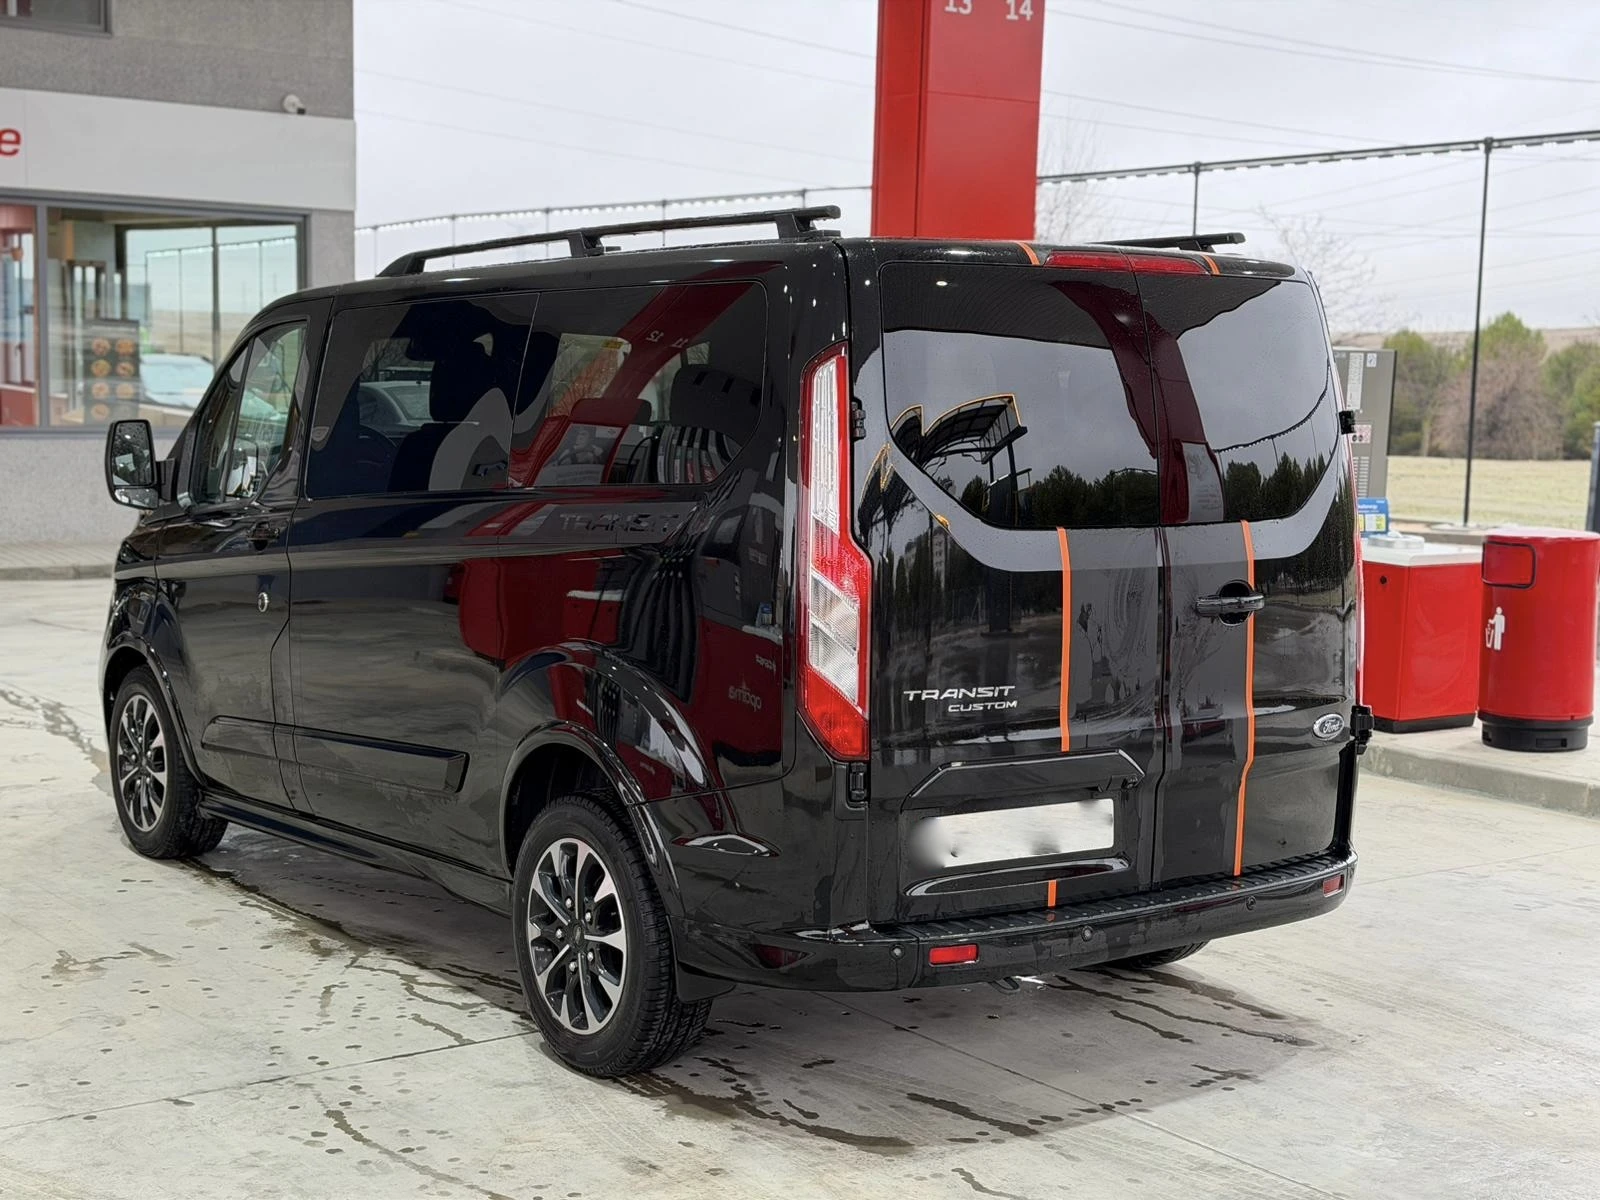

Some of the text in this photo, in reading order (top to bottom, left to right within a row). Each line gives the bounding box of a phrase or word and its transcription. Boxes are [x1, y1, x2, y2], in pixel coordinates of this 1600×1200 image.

[1005, 0, 1034, 21] 14
[0, 128, 21, 156] e
[903, 685, 1016, 702] TRANSIT
[947, 700, 1018, 713] CUSTOM
[1322, 718, 1341, 734] Ford
